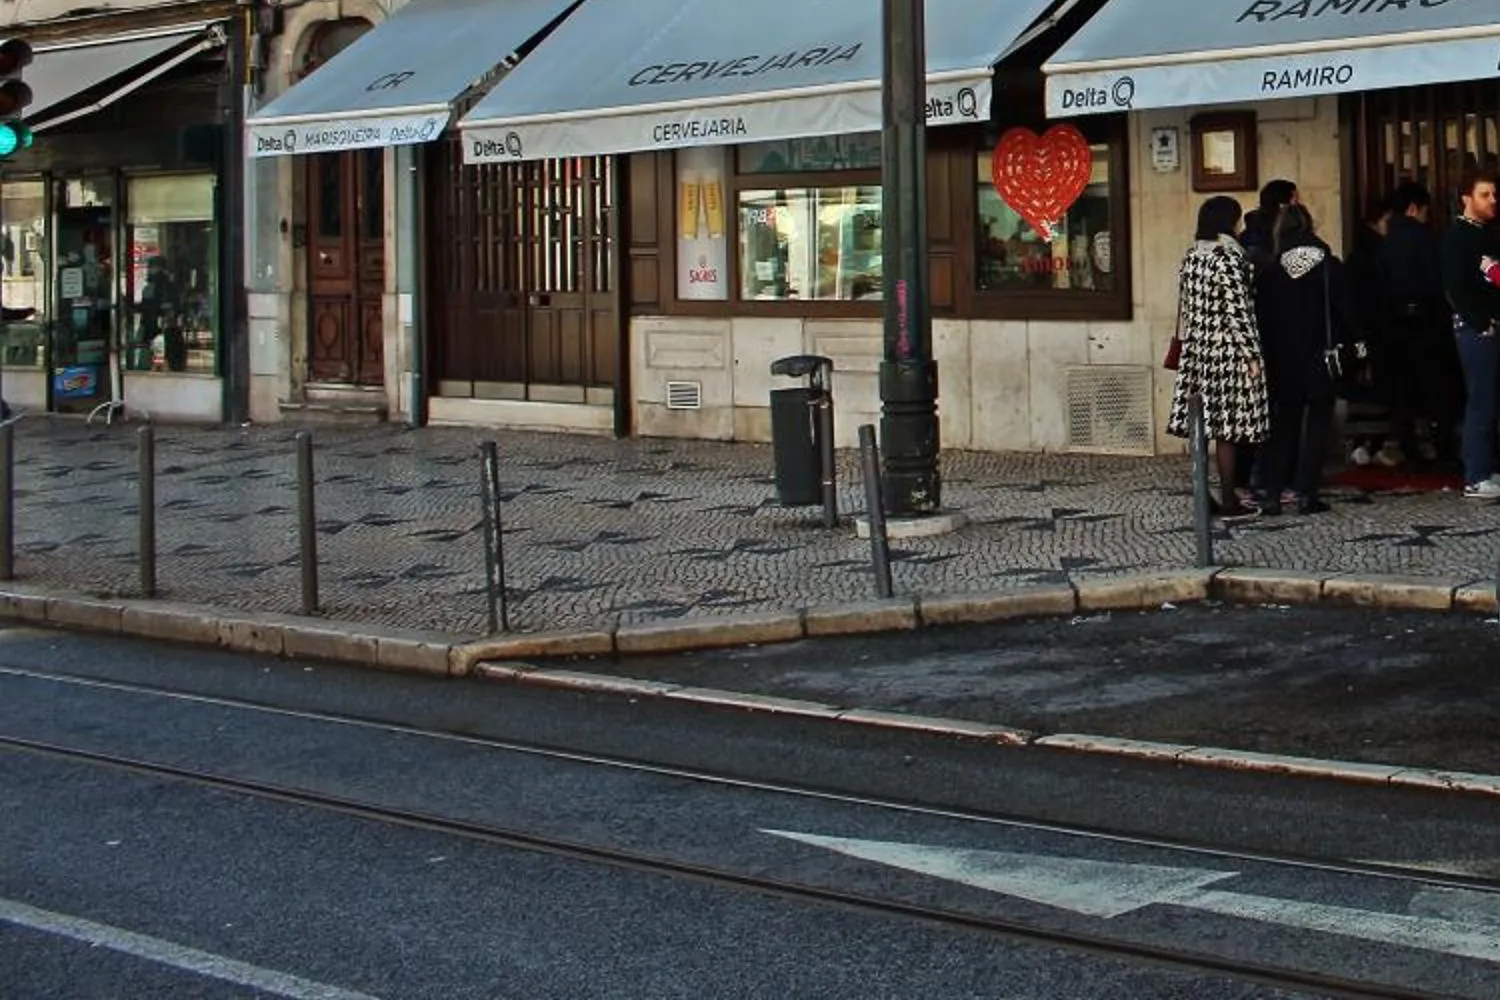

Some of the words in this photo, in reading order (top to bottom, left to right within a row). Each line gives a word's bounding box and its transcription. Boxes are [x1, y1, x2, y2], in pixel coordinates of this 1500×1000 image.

[628, 42, 863, 87] CERVEJARIA
[365, 71, 416, 92] CR
[1261, 64, 1354, 92] RAMIRO
[924, 96, 953, 119] elta
[1062, 87, 1107, 109] Delta
[305, 126, 382, 147] MARISQUEIRA
[653, 117, 748, 143] CERVEJARIA
[257, 134, 283, 152] Delta
[473, 138, 505, 157] Delta
